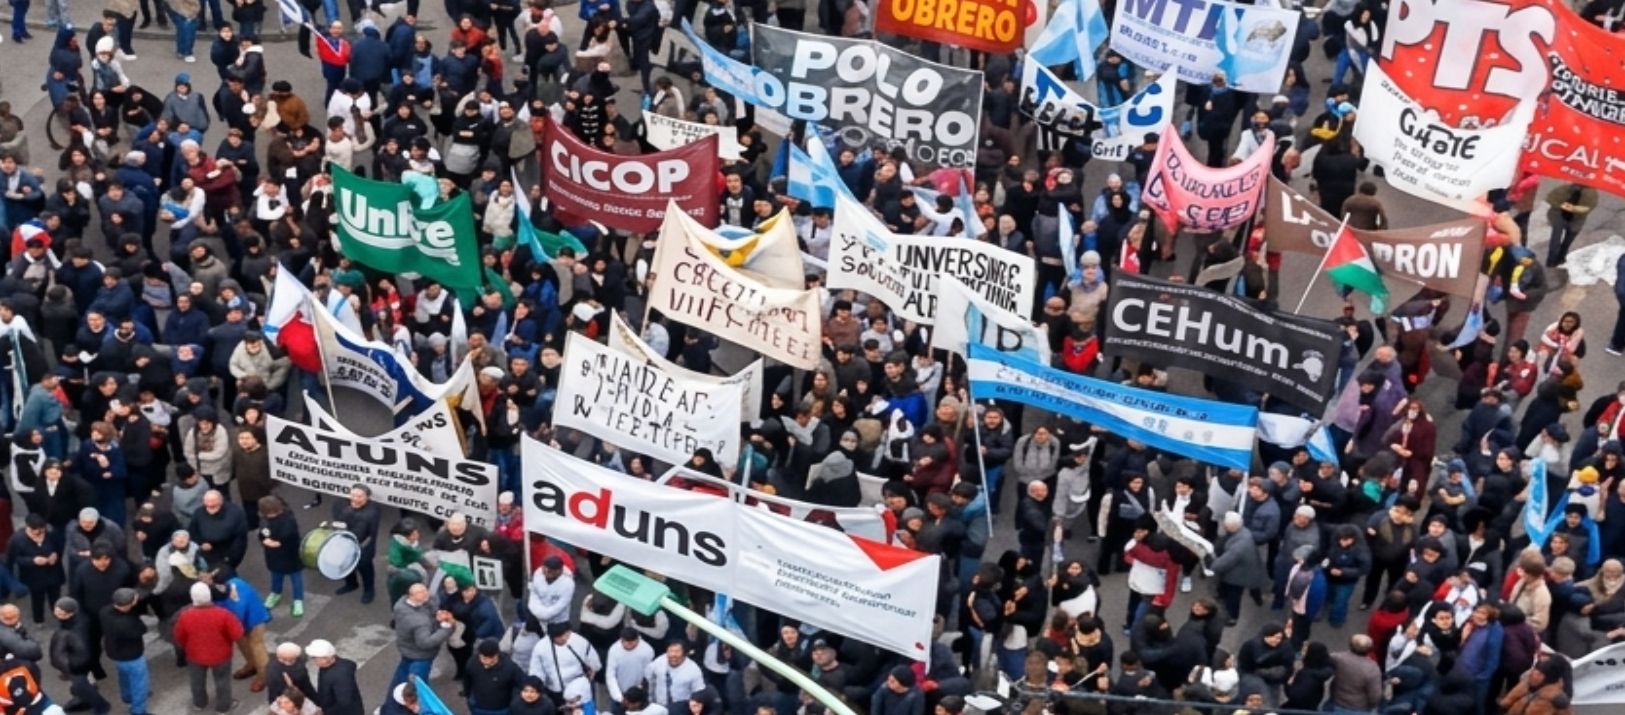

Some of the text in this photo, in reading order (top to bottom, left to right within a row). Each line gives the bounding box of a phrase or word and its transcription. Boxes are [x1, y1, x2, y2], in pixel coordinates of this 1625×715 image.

[891, 0, 1017, 42] OBRERO
[1381, 0, 1556, 101] PTS
[752, 68, 976, 147] OBRERO
[790, 39, 944, 106] POLO
[550, 139, 690, 194] CICOP
[1112, 297, 1289, 370] CEHum
[532, 479, 727, 567] aduns
